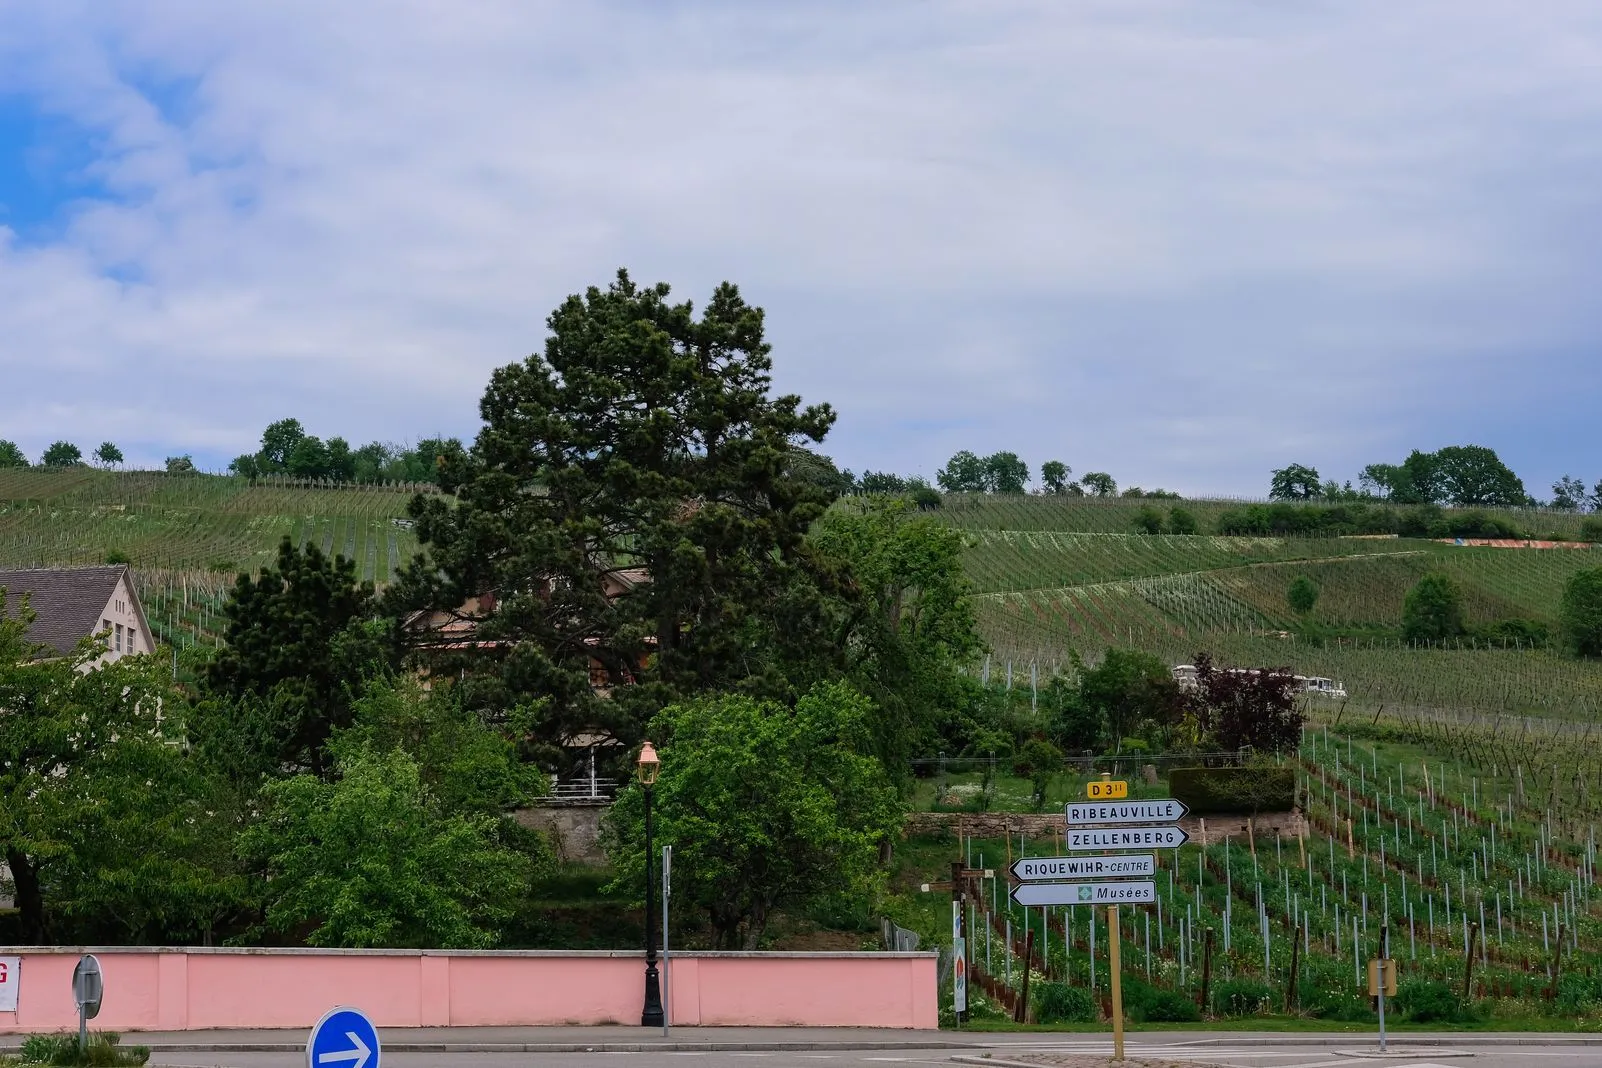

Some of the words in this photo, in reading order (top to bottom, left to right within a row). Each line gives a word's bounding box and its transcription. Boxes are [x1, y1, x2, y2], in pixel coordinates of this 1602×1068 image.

[1093, 785, 1100, 796] D
[1072, 803, 1173, 819] RIBEAUVILLÉ
[1073, 832, 1174, 845] ZELLENBERG
[1097, 887, 1149, 899] Musées
